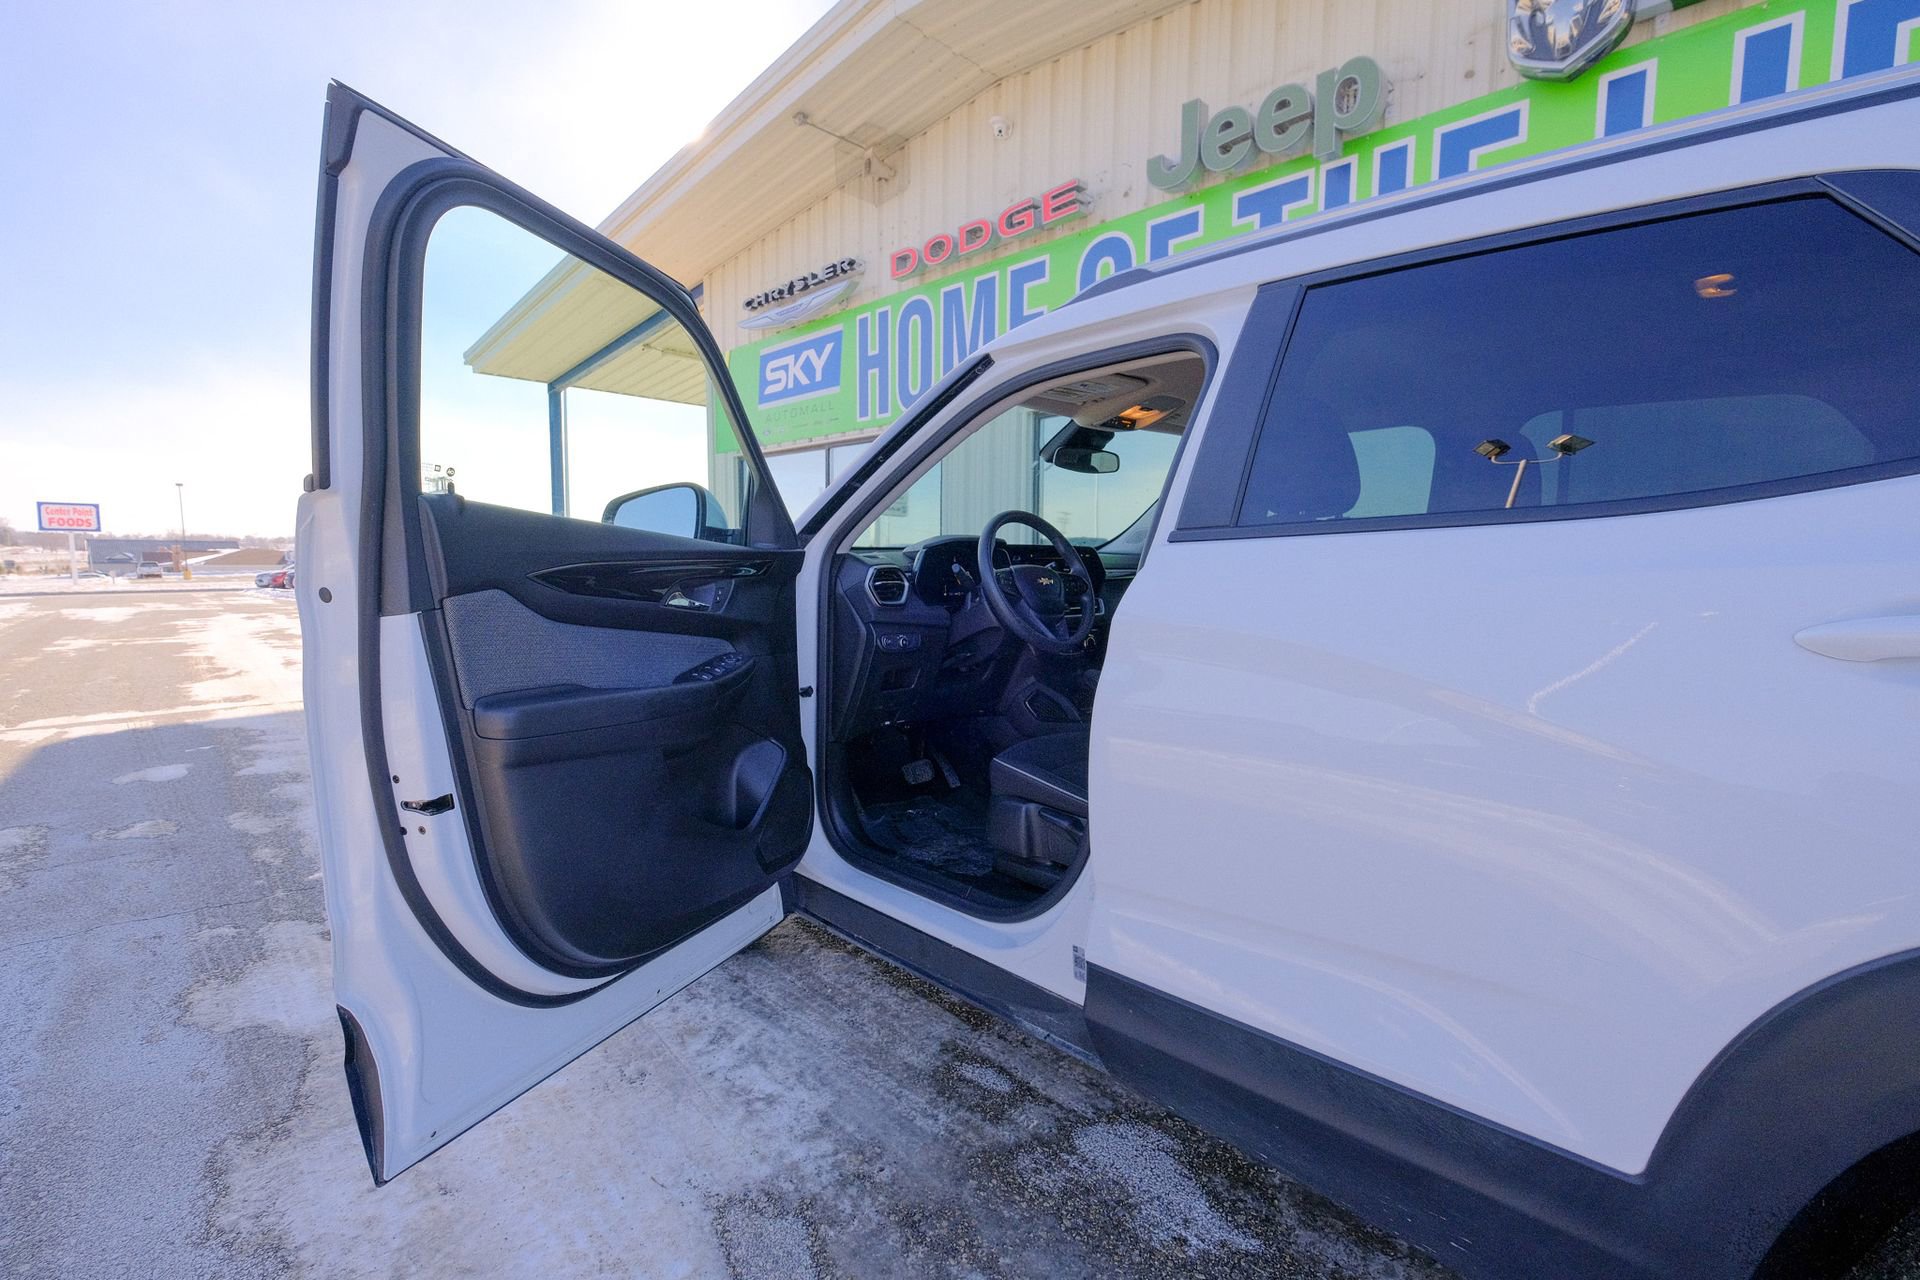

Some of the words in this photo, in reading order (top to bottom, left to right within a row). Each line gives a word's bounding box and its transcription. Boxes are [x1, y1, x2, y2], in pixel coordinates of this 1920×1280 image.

[1146, 56, 1383, 191] Jeep
[890, 178, 1086, 280] DODGE
[744, 257, 857, 311] CHRYSLER
[764, 342, 835, 396] SKY
[765, 400, 835, 424] AUTOMALL
[45, 506, 70, 516] Center
[72, 507, 94, 516] Point
[47, 517, 93, 528] FOODS
